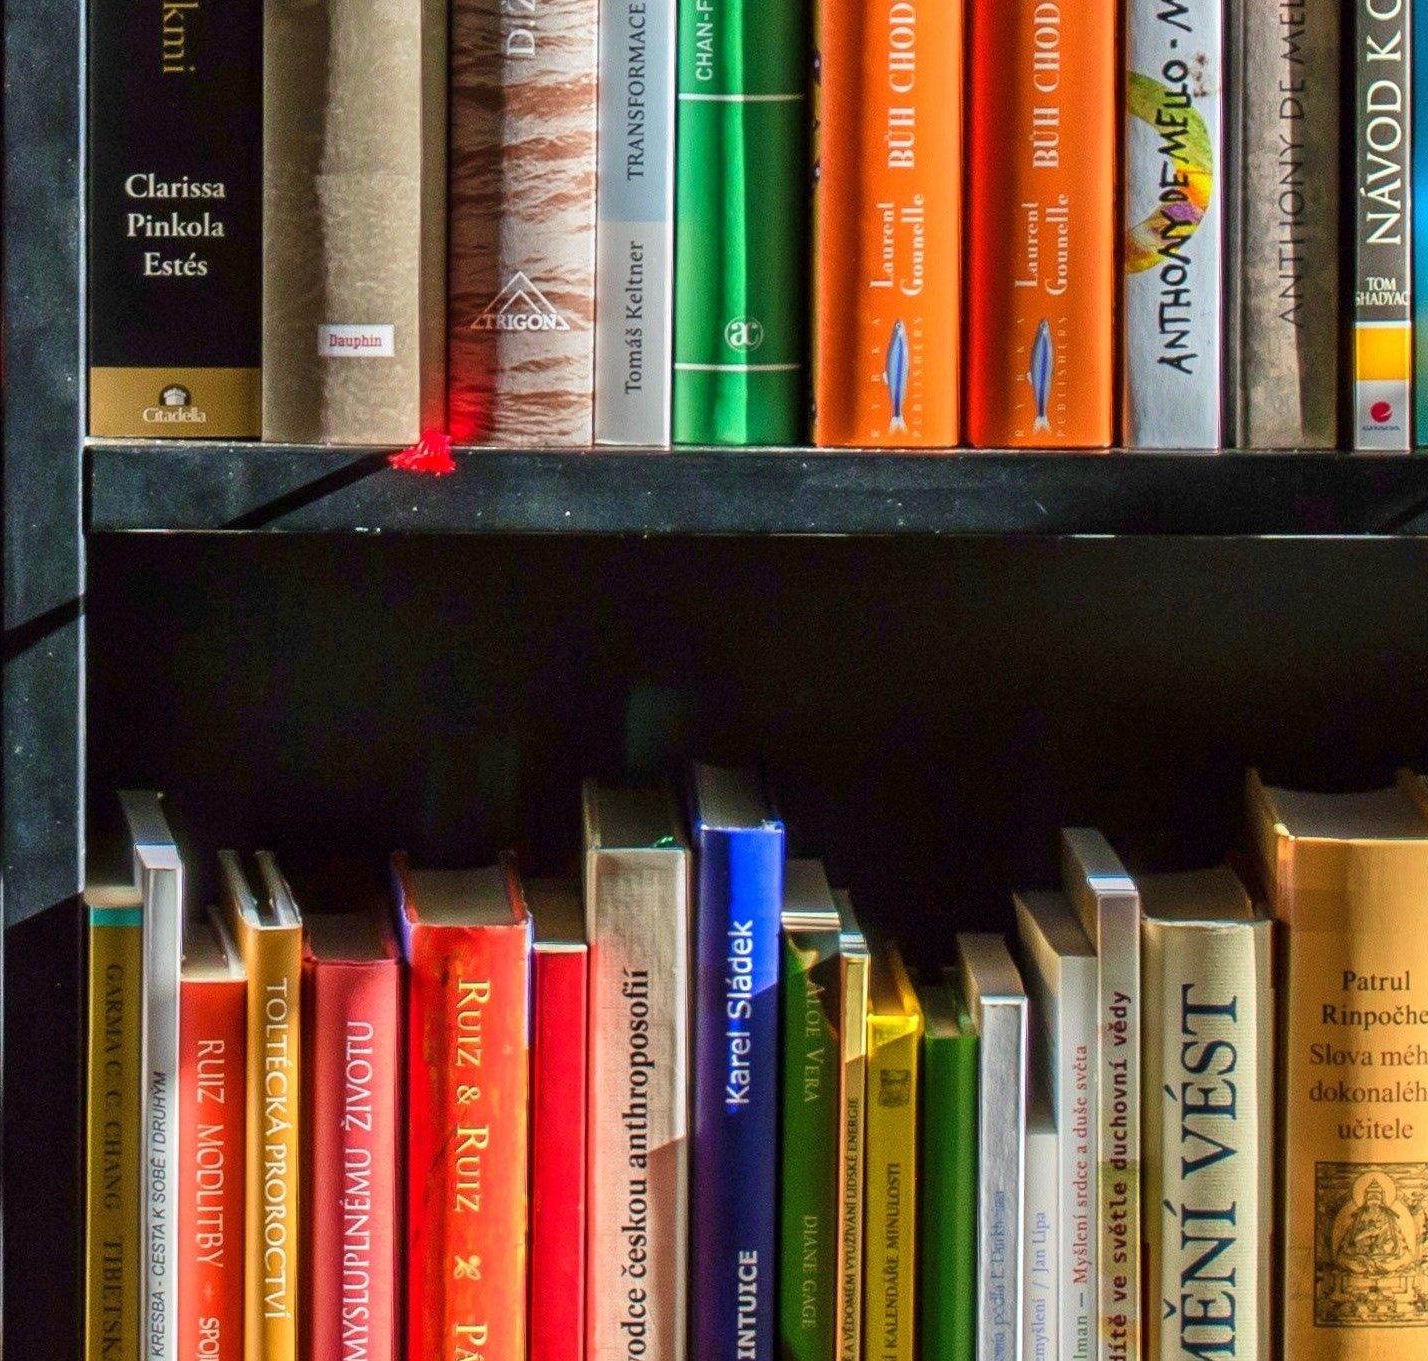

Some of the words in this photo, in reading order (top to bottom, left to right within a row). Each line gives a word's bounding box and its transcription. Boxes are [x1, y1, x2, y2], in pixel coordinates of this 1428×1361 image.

[1366, 30, 1402, 62] K
[884, 105, 916, 169] BŮH
[1359, 80, 1402, 245] NÁVOD
[125, 173, 225, 199] Clarissa
[127, 213, 224, 237] Pinkola
[869, 201, 895, 289] Laurent
[899, 193, 925, 297] Gounelle
[143, 252, 208, 277] Estés
[623, 240, 643, 320] Keltner
[329, 333, 382, 349] Dauphin
[624, 328, 643, 395] Tomáš
[724, 919, 753, 1020] Sládek
[1342, 970, 1411, 991] Patrul
[456, 978, 491, 1067] RUIZ
[1309, 1042, 1373, 1066] Slova
[197, 1039, 225, 1104] RUIZ
[264, 977, 292, 1137] TOLTÉCKÁ
[725, 1031, 751, 1105] Karel
[456, 1084, 481, 1105] &
[1336, 1118, 1413, 1140] učitele
[197, 1123, 225, 1268] MODLITBY
[453, 1124, 491, 1213] RUIZ
[263, 1143, 291, 1320] PROROCTVÍ
